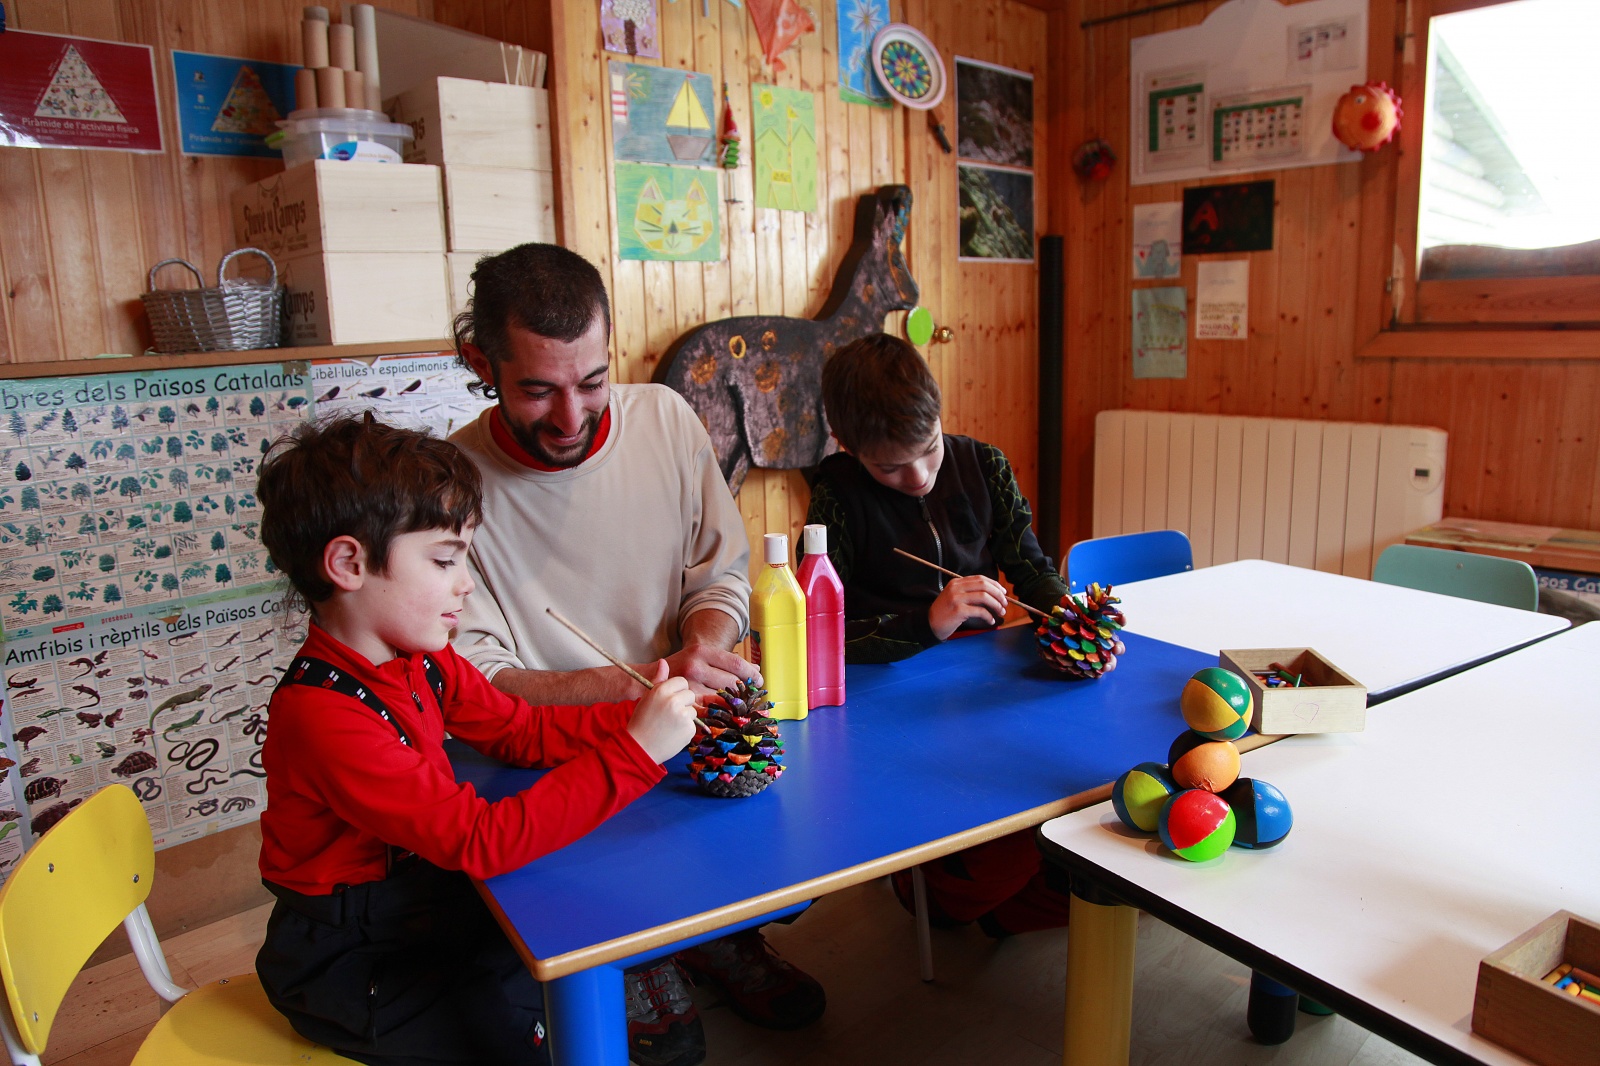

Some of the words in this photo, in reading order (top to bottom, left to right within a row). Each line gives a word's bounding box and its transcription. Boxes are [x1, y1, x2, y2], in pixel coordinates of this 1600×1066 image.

[22, 116, 62, 129] Piràmide
[63, 120, 75, 130] de
[76, 121, 115, 132] l'activitat
[116, 124, 140, 135] física
[311, 365, 368, 380] ibèl·lules
[379, 361, 448, 377] espiadimonis
[2, 388, 65, 410] bres
[74, 381, 126, 404] dels
[134, 377, 206, 398] Països
[213, 369, 304, 393] Catalans
[5, 637, 83, 666] Amfibis
[89, 633, 94, 649] i
[100, 621, 160, 648] rèptils
[166, 614, 201, 633] dels
[206, 605, 256, 626] Països
